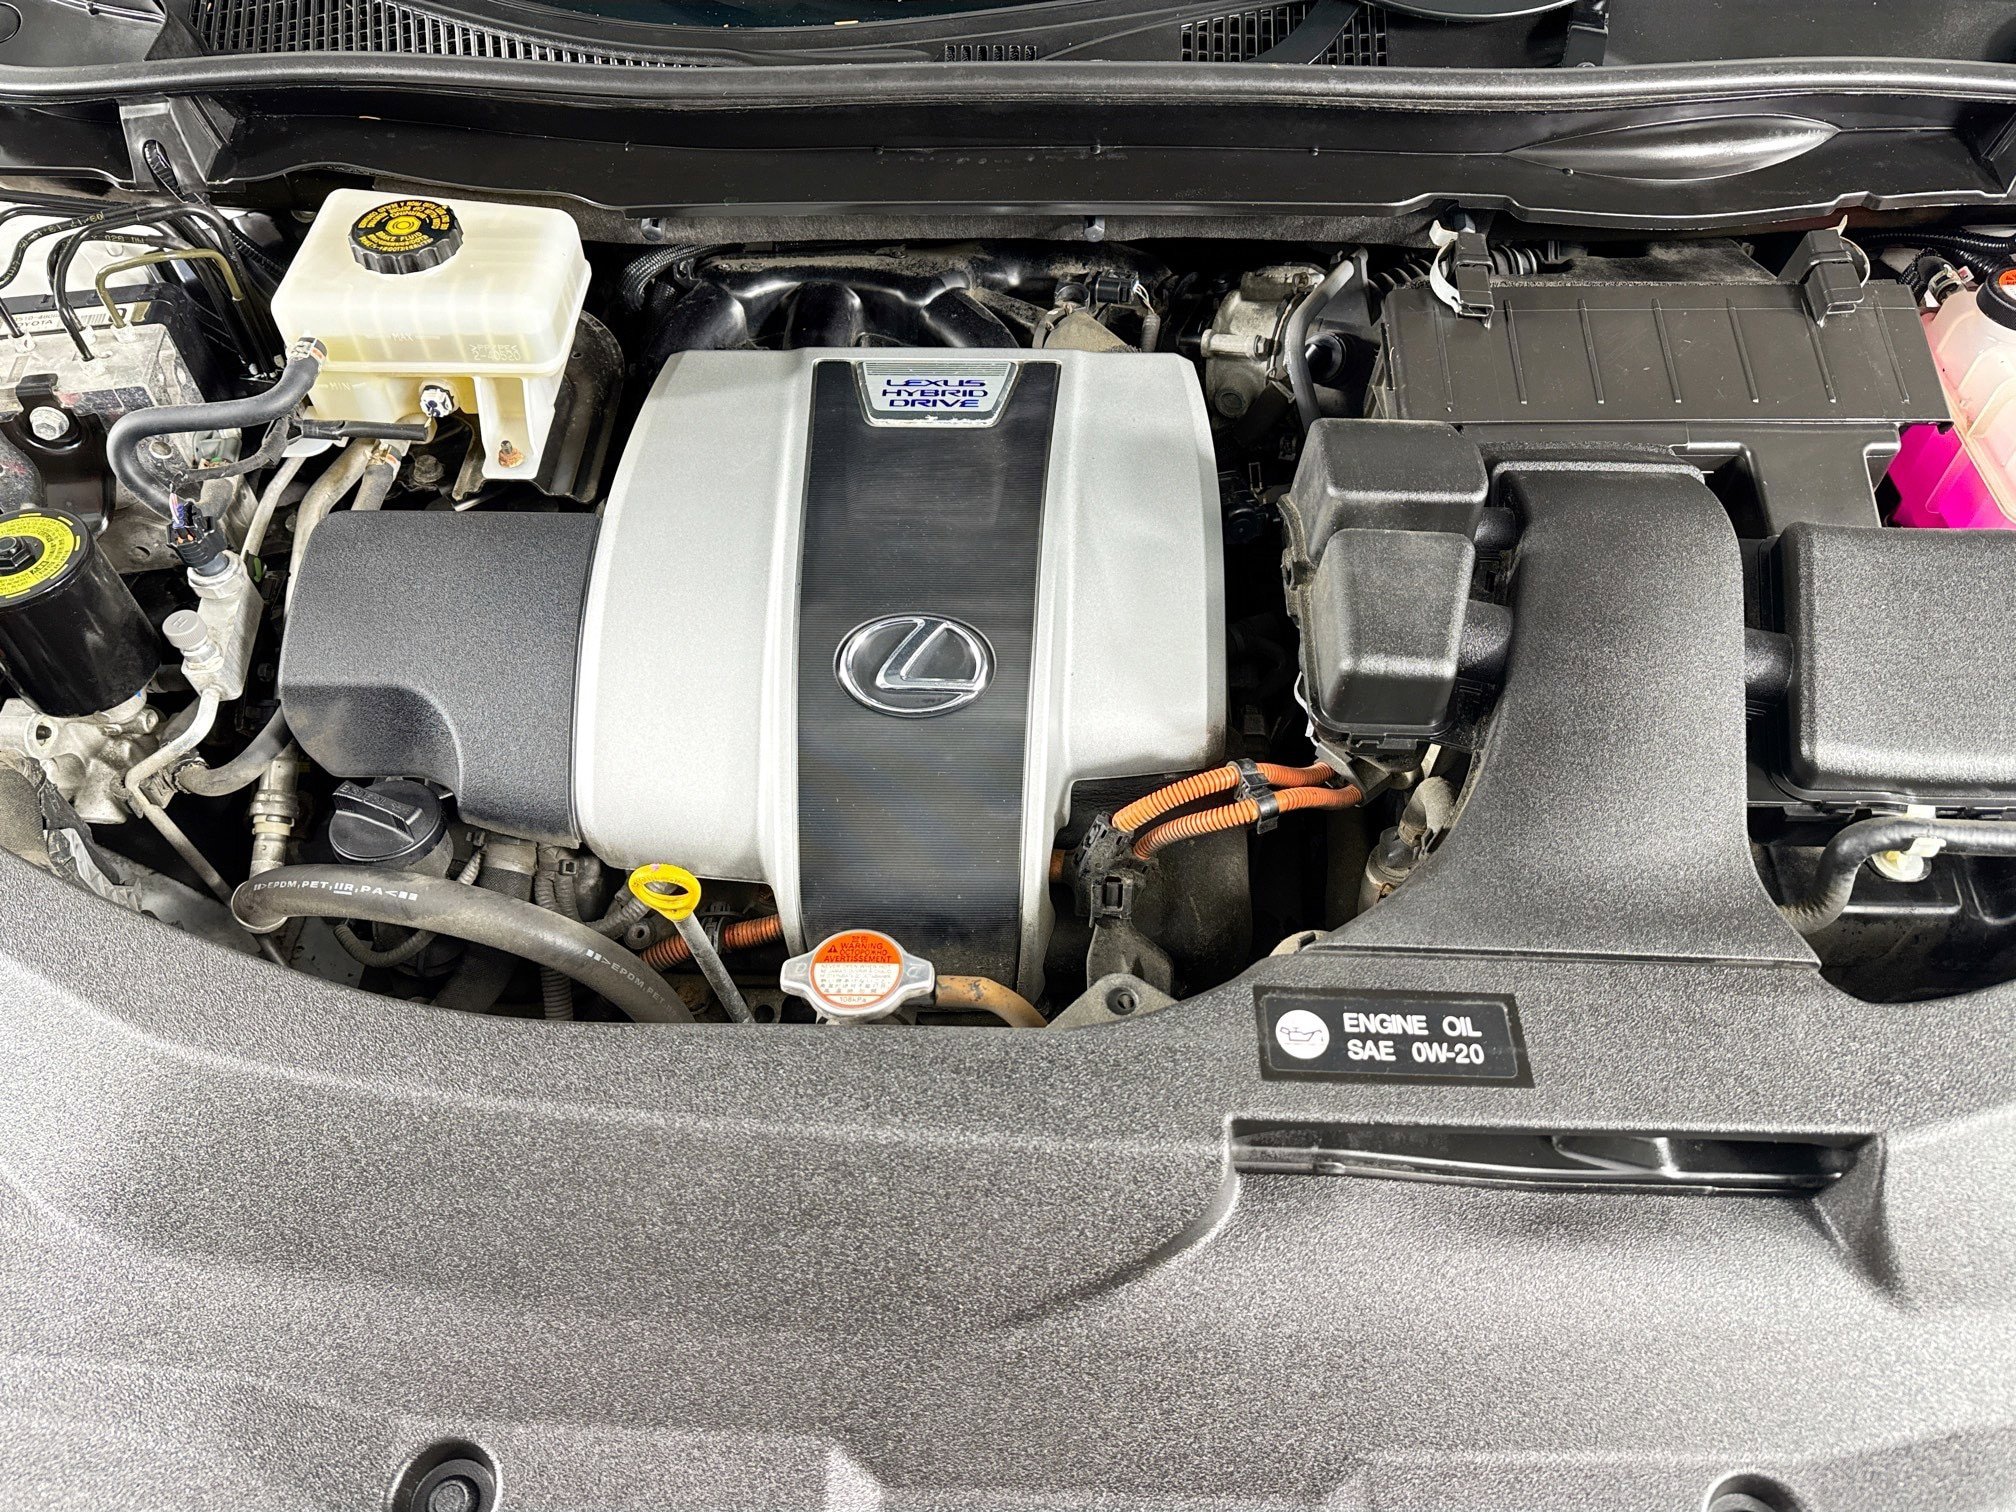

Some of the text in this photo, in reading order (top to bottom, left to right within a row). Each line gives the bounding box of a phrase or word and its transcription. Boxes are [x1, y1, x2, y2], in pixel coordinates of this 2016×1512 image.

[400, 231, 423, 242] FLUID
[886, 379, 986, 387] LEXUS
[882, 389, 988, 397] HYBRID
[889, 399, 979, 407] DRIVE
[823, 955, 892, 963] AVERTISSEMENT
[1343, 1012, 1483, 1038] ENGINE OIL
[1347, 1039, 1485, 1065] SAE 0W-20
